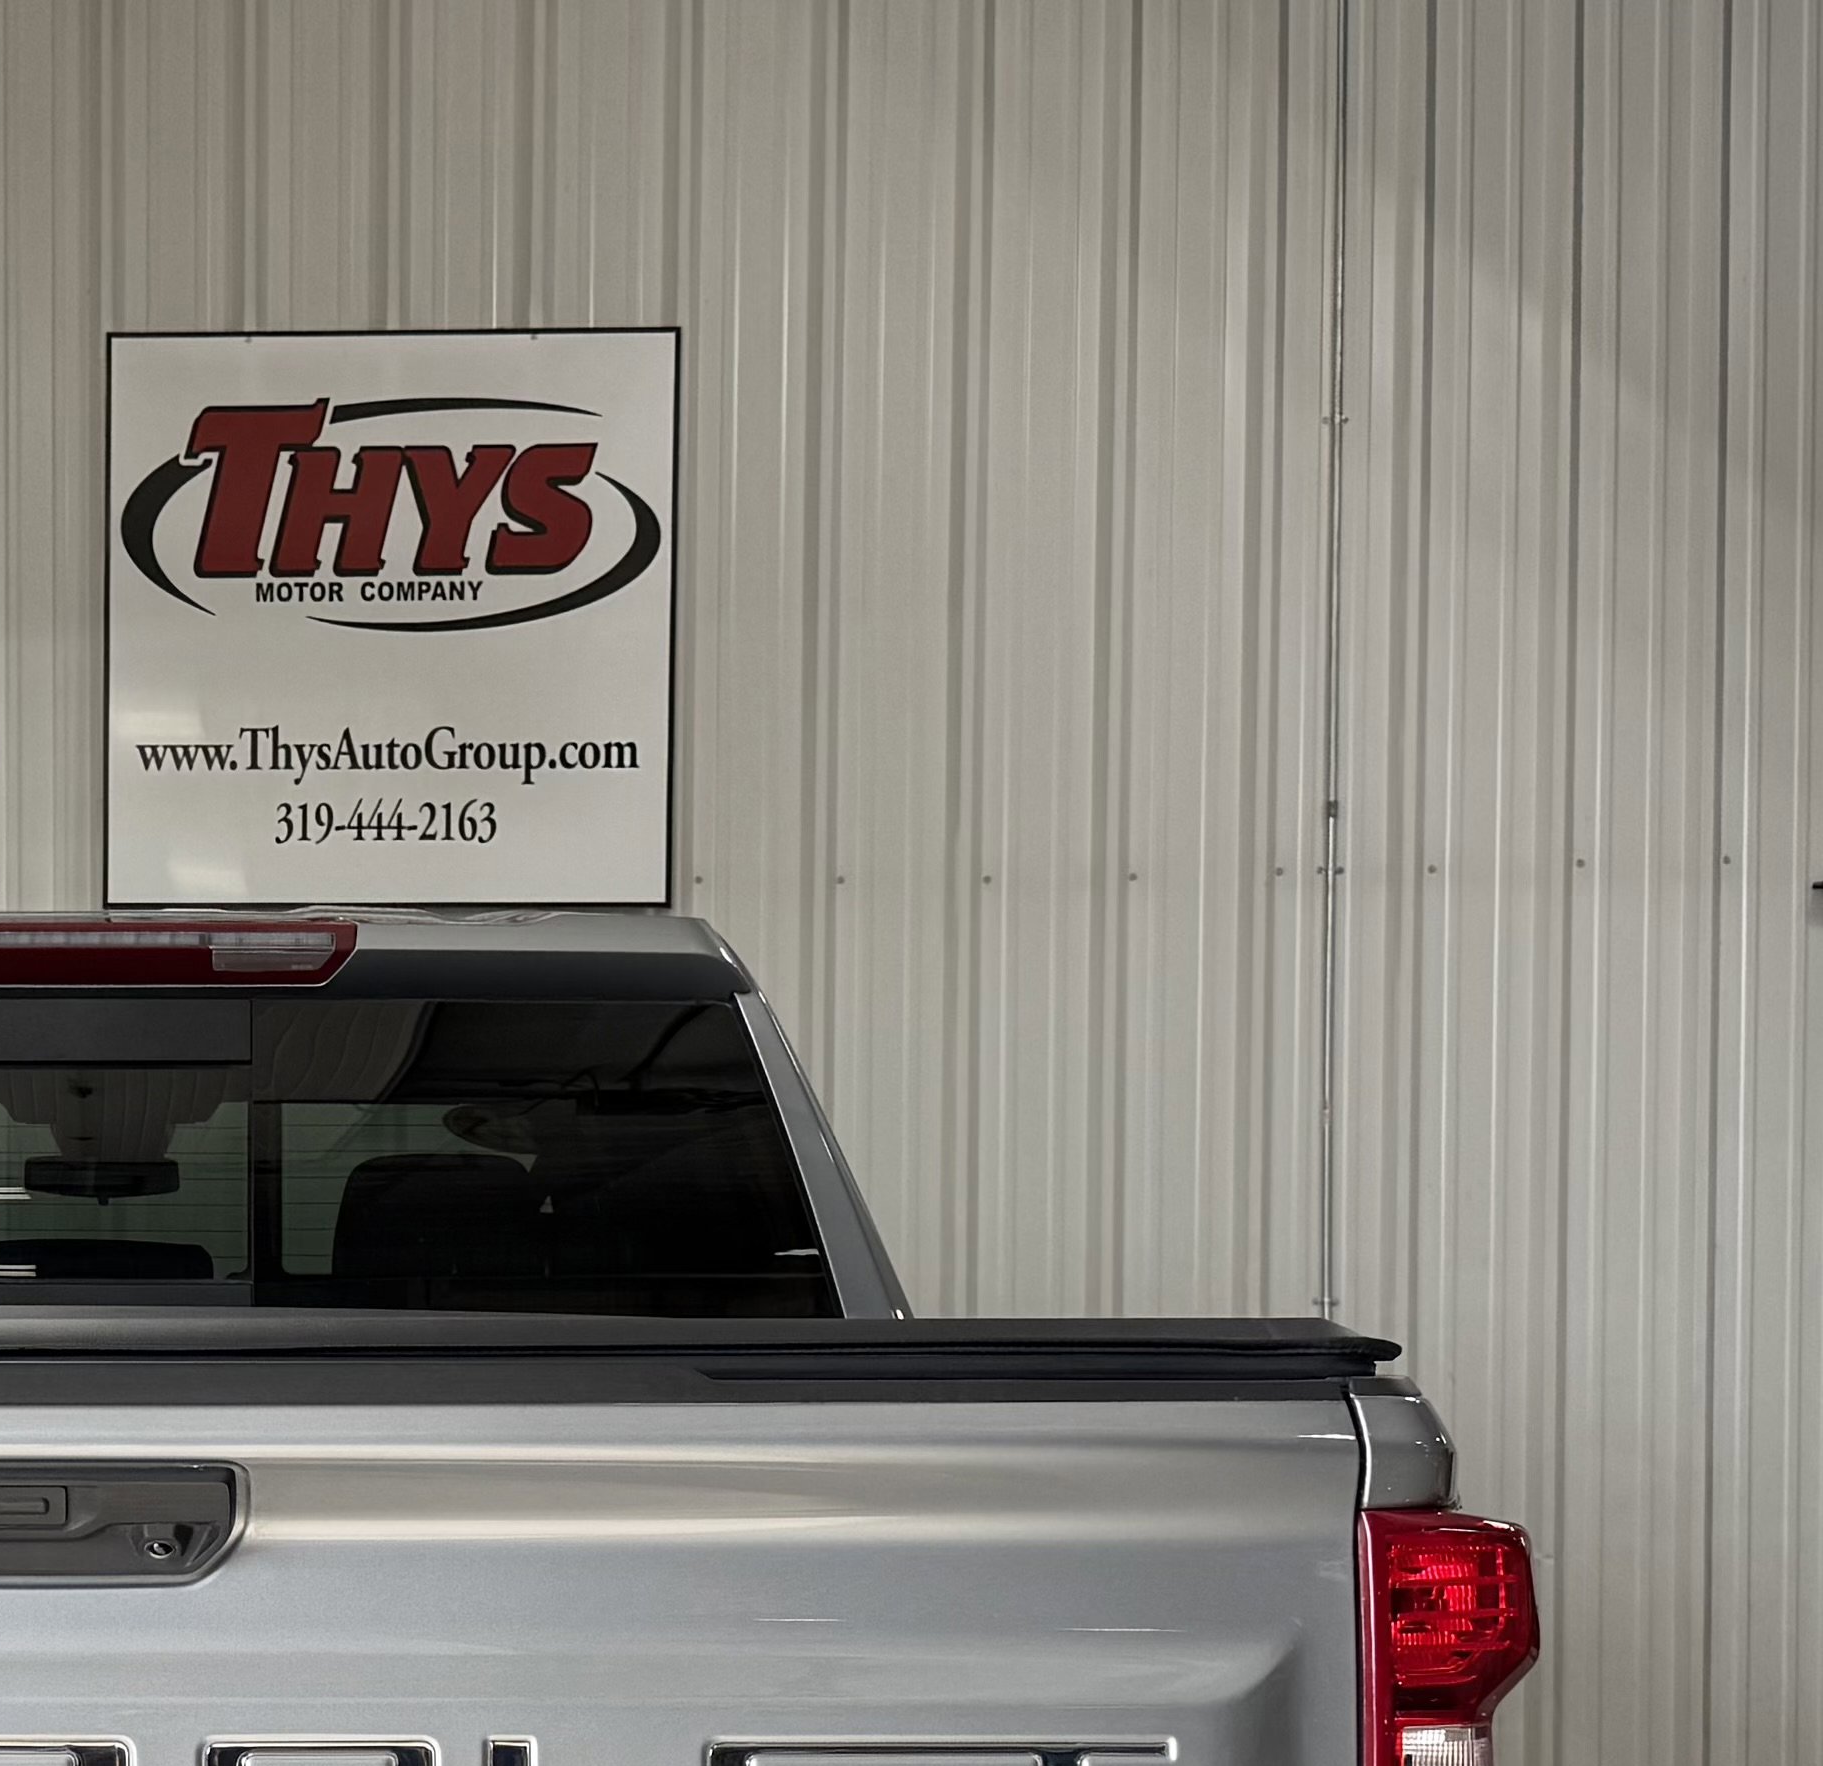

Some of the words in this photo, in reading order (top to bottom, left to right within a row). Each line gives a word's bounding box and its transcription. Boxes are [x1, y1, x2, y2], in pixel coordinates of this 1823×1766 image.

[185, 397, 599, 578] THYS
[255, 582, 344, 603] MOTOR
[360, 581, 483, 601] COMPANY
[136, 725, 641, 786] www.ThysAutoGroup.com
[274, 798, 498, 845] 319-444-2163
